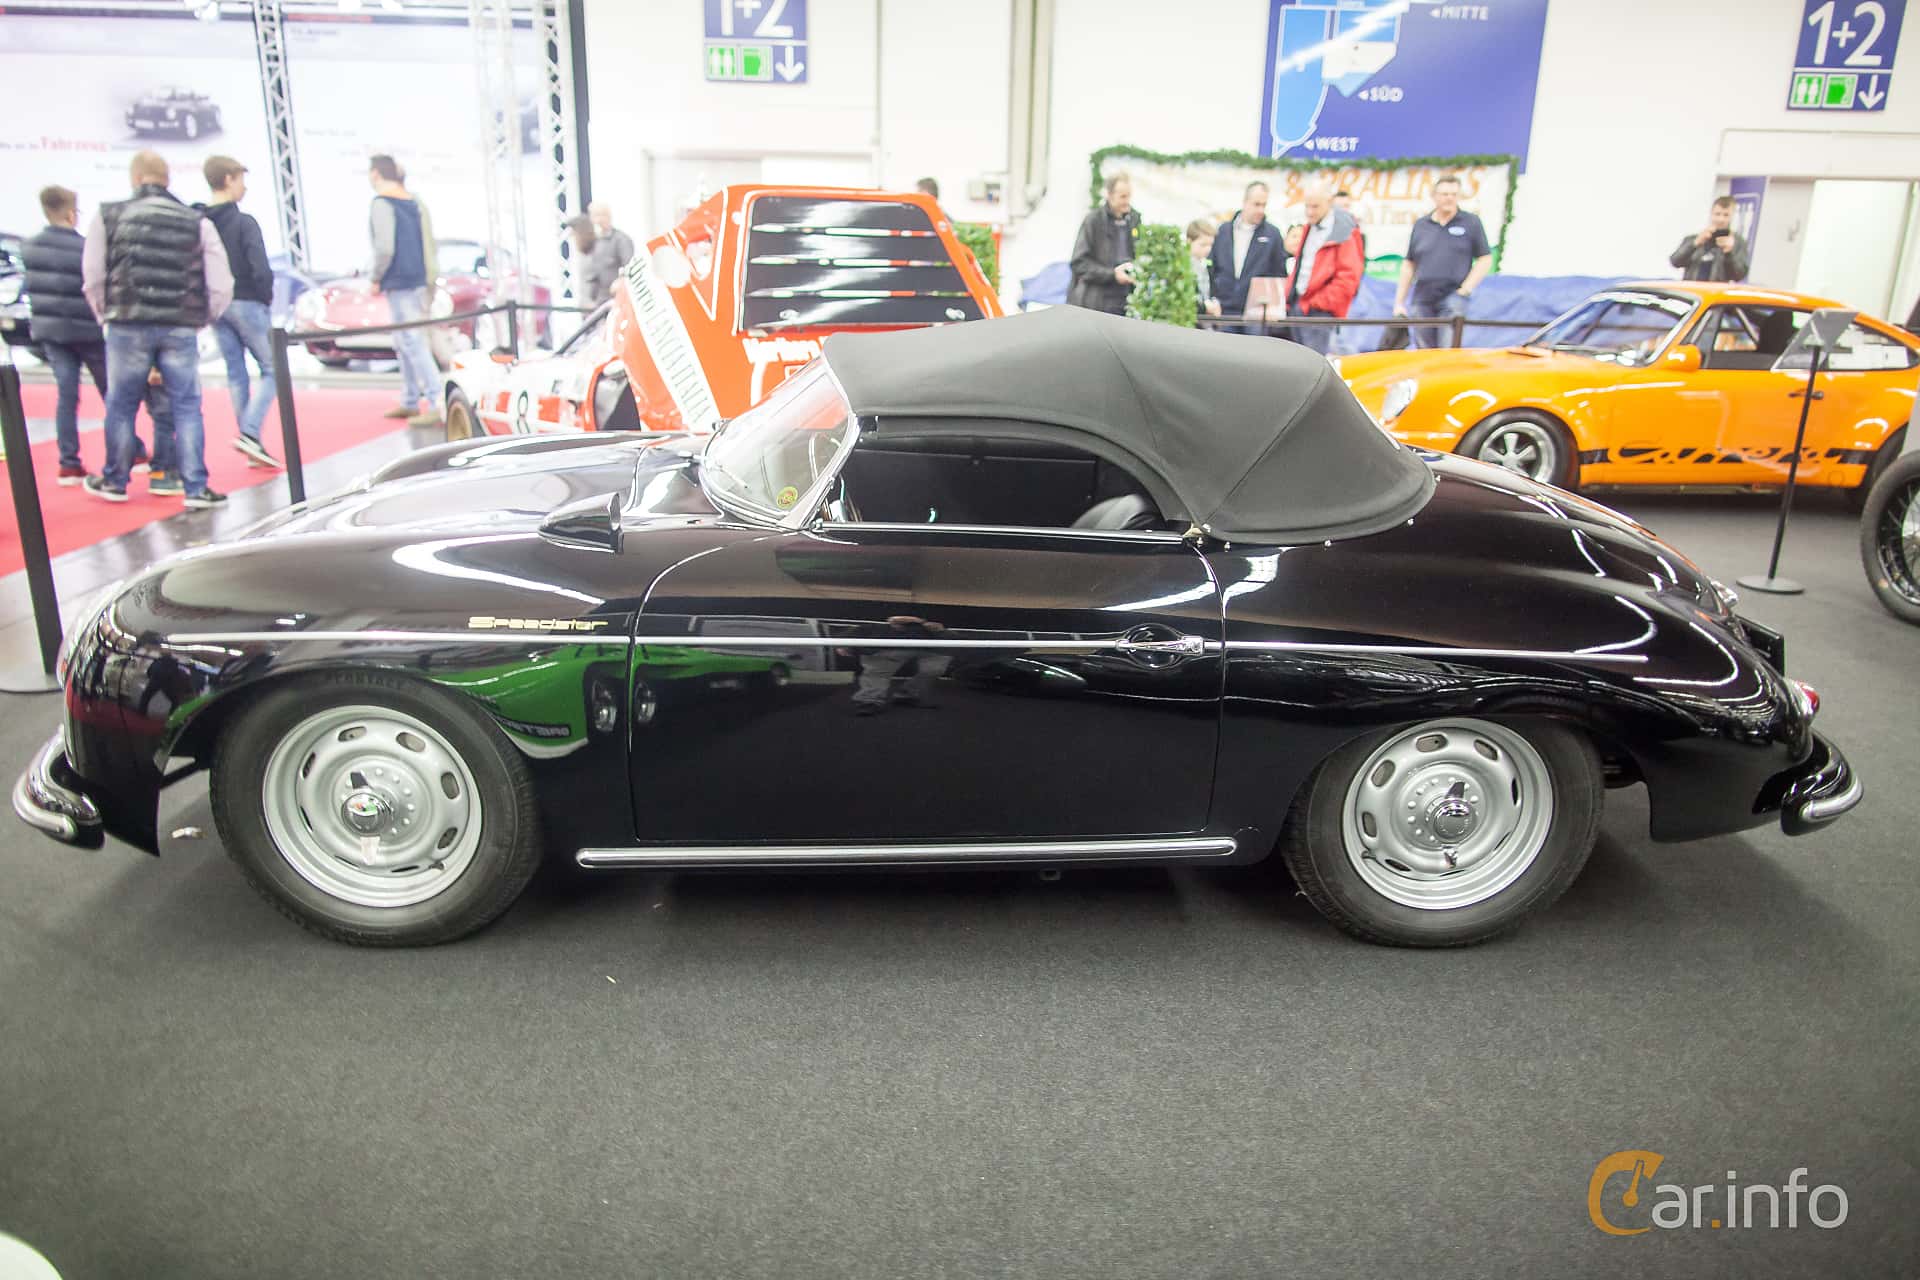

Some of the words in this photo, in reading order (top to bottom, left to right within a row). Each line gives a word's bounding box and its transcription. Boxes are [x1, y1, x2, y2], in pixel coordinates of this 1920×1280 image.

[1441, 6, 1489, 21] MITTE
[1808, 1, 1886, 66] 1+2
[1369, 86, 1404, 102] SÜD
[1316, 136, 1359, 152] WEST
[468, 616, 608, 631] Speedster
